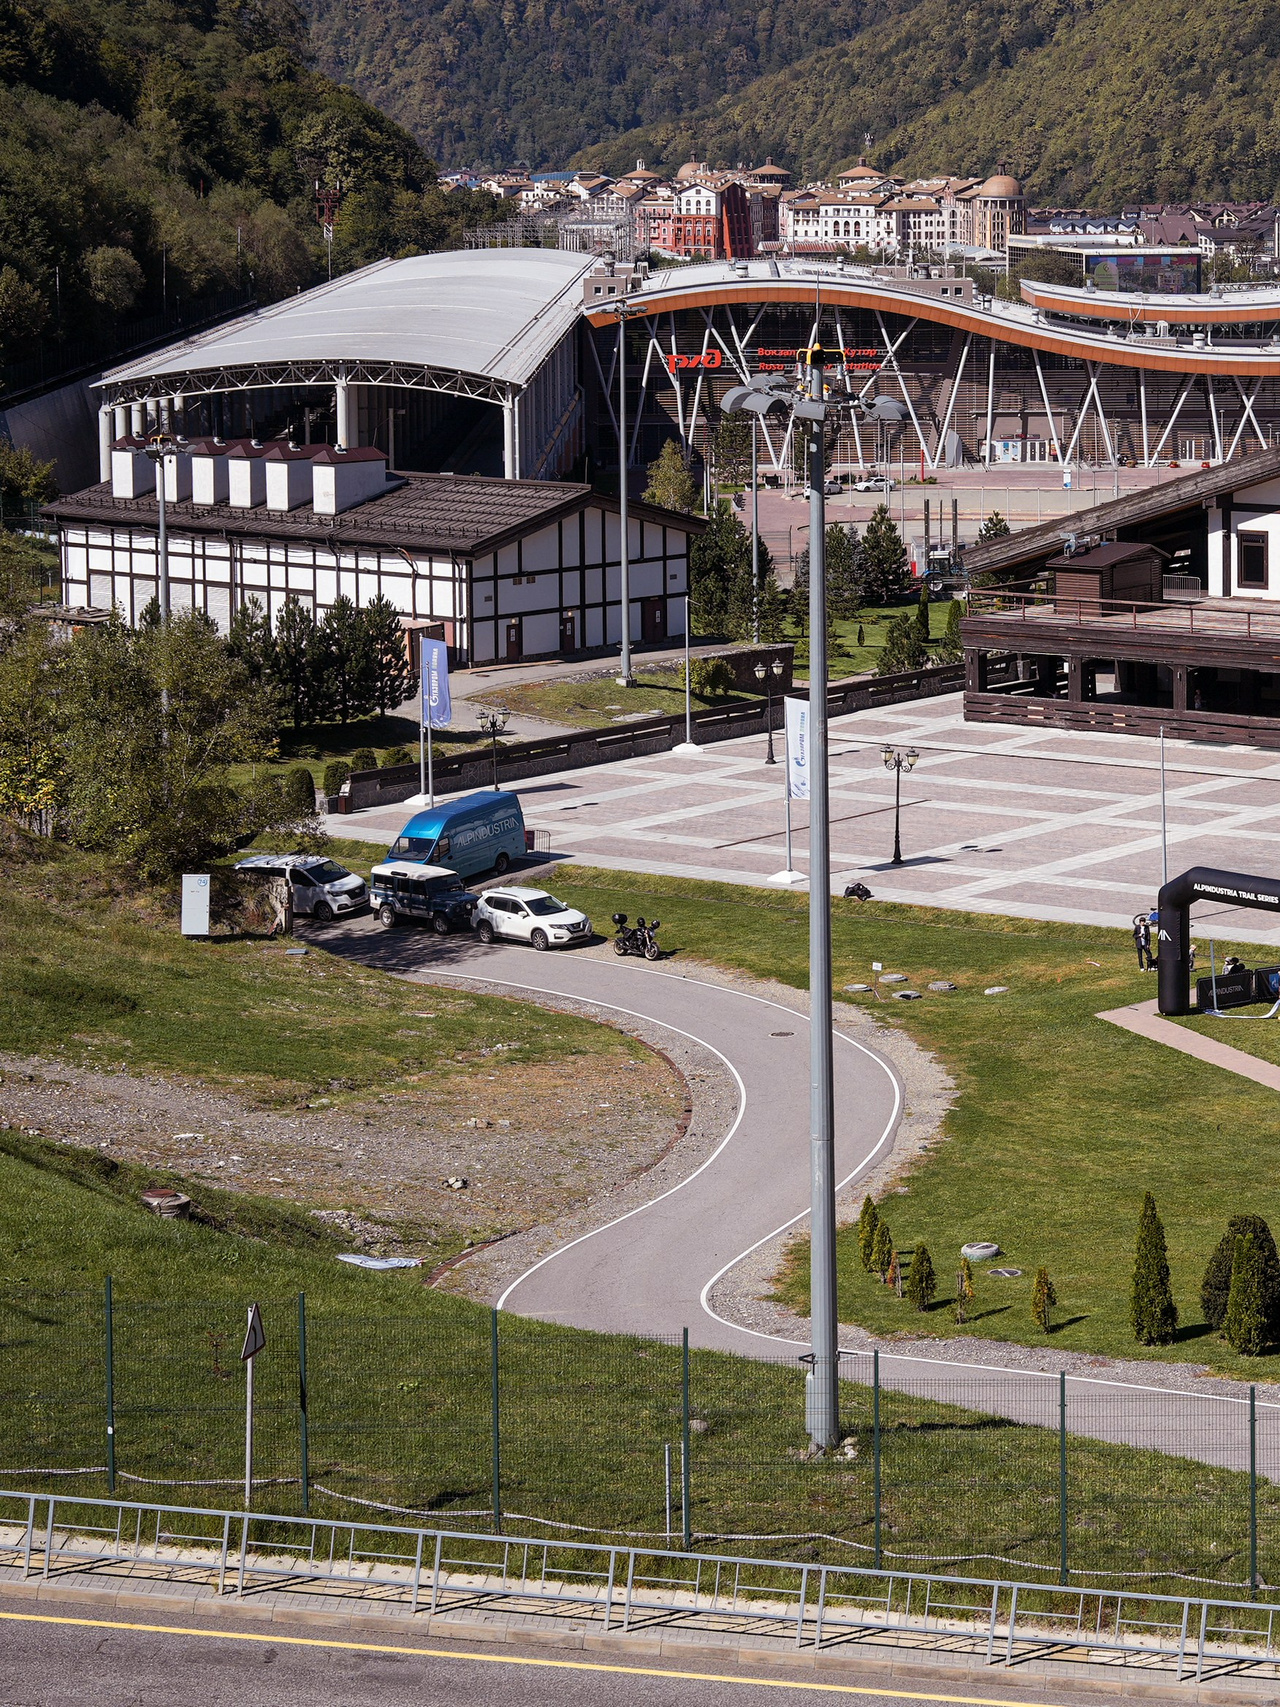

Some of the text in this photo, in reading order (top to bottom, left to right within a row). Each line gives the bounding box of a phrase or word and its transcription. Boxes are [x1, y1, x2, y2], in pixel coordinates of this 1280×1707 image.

[456, 816, 520, 848] ALPINDUSTRIA
[1193, 882, 1279, 904] ALPINDUSTRIA TRAIL SERIES
